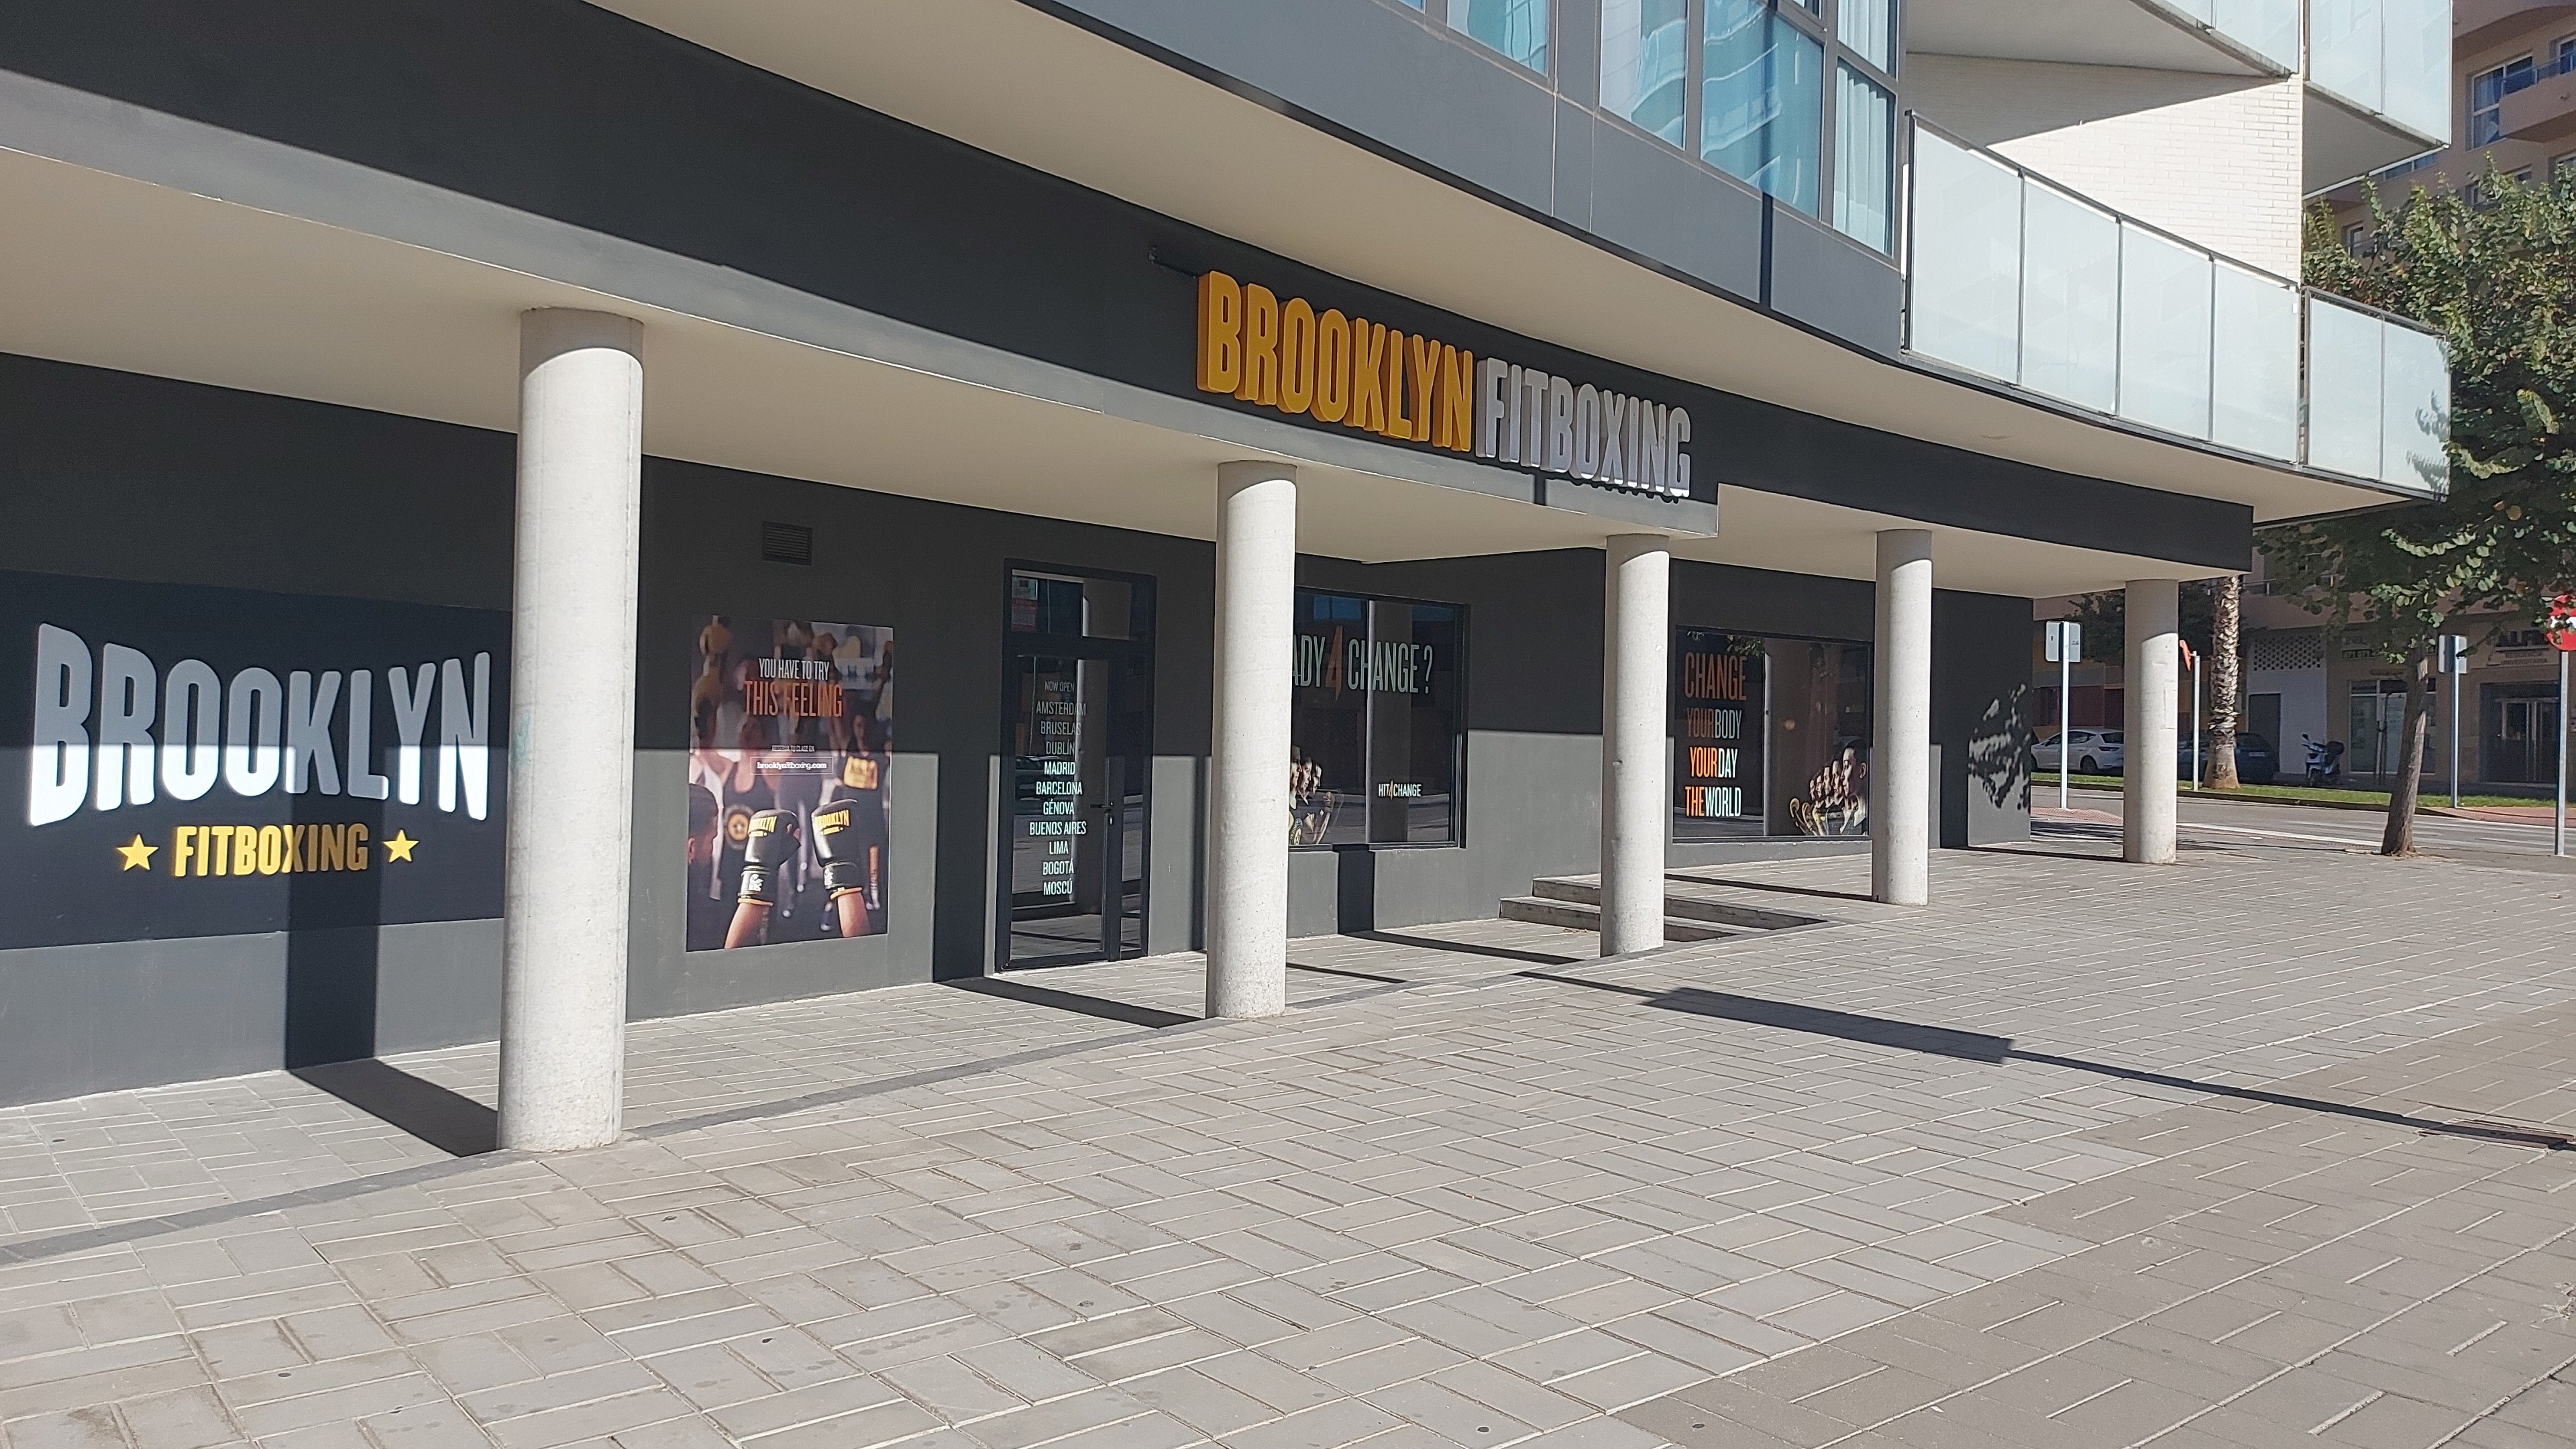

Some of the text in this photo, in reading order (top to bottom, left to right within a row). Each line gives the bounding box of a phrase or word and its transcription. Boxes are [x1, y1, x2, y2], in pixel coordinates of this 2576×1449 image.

[1197, 271, 1691, 498] BROOKLYN FITBOXING
[759, 658, 830, 680] YOU HAVE TO TRY
[1326, 626, 1343, 702] 4
[1348, 639, 1419, 693] CHANGE
[1684, 651, 1748, 700] CHANGE
[1044, 681, 1075, 692] NOW OPEN
[745, 680, 843, 717] THIS FEELING
[1036, 701, 1086, 716] AMSTERDAM
[30, 623, 490, 826] BROOKLYN
[1040, 721, 1081, 736] BRUSELAS
[1046, 739, 1075, 755] DUBLÍN
[1044, 761, 1076, 775] MADRID
[1036, 782, 1083, 795] BARCELONA
[1043, 798, 1075, 815] GÉNOVA
[1029, 821, 1087, 835] BUENOS AIRES
[175, 823, 369, 877] FITBOXING
[1049, 841, 1069, 855] LIMA
[1042, 857, 1075, 875] BOGOTÁ
[1043, 878, 1073, 896] MOSCÚ
